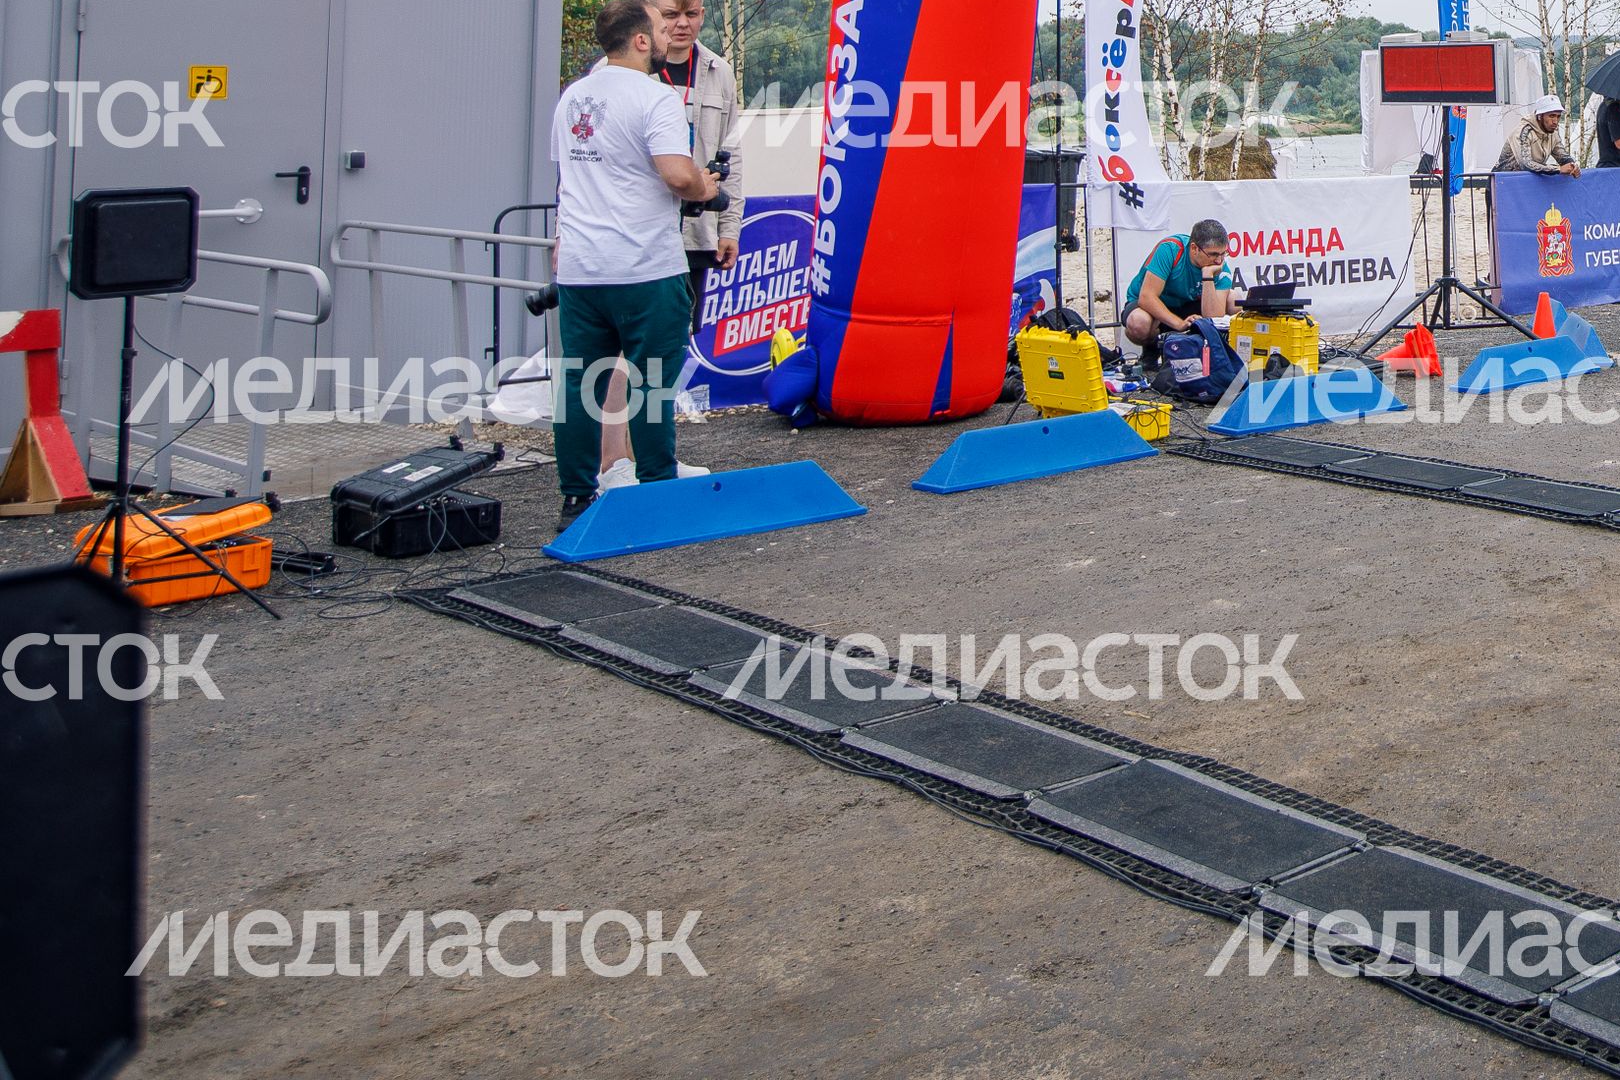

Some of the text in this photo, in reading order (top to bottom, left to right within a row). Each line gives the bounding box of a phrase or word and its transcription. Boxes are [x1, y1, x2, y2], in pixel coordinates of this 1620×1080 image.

[1226, 227, 1345, 258] ОМАНДА
[1255, 256, 1397, 288] КРЕМЛЕВА
[701, 265, 811, 329] ДАЛЬШЕ!
